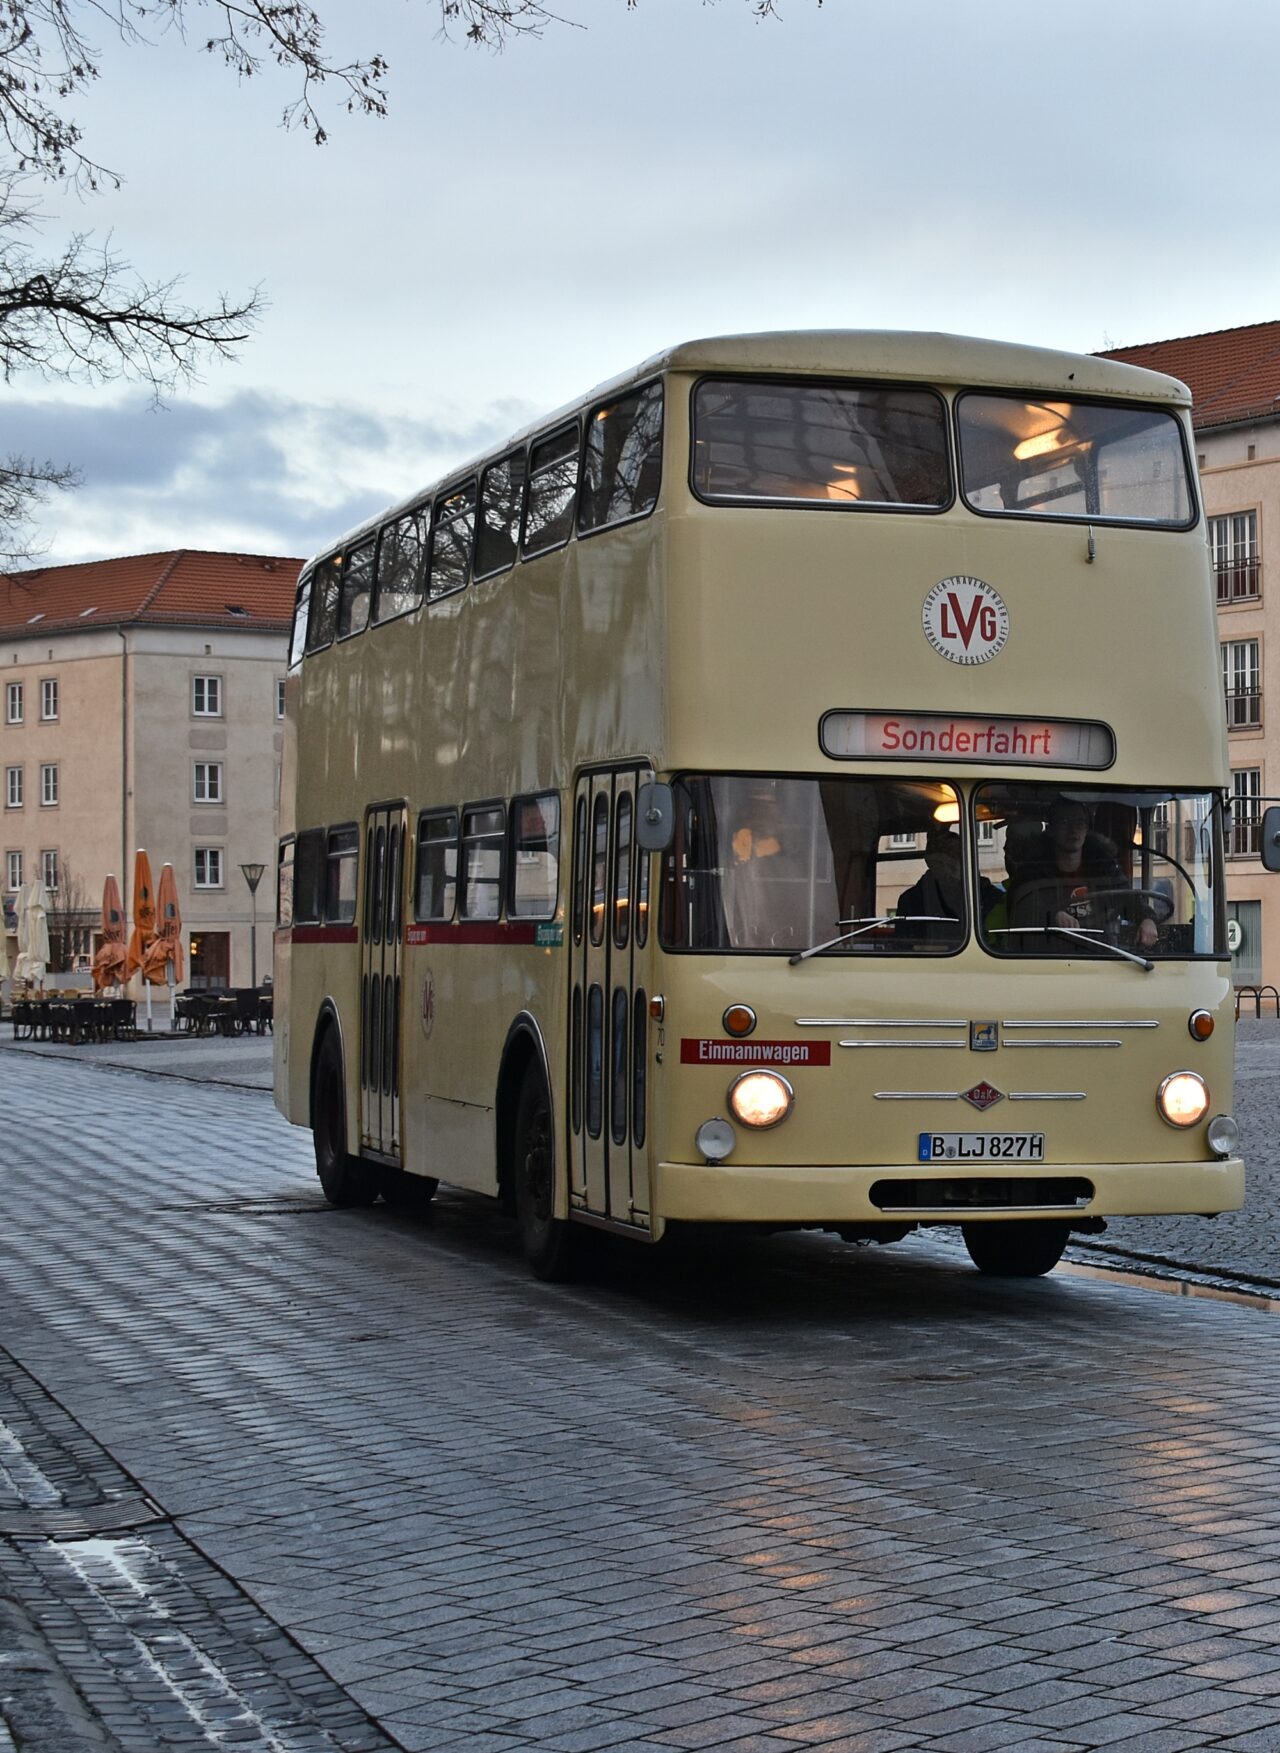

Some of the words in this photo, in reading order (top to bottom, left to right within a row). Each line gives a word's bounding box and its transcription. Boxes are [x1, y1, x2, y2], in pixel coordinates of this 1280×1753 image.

[941, 592, 997, 651] LVG
[881, 720, 1052, 755] Sonderfahrt
[699, 1040, 809, 1064] Einmannwagen
[931, 1136, 945, 1157] B
